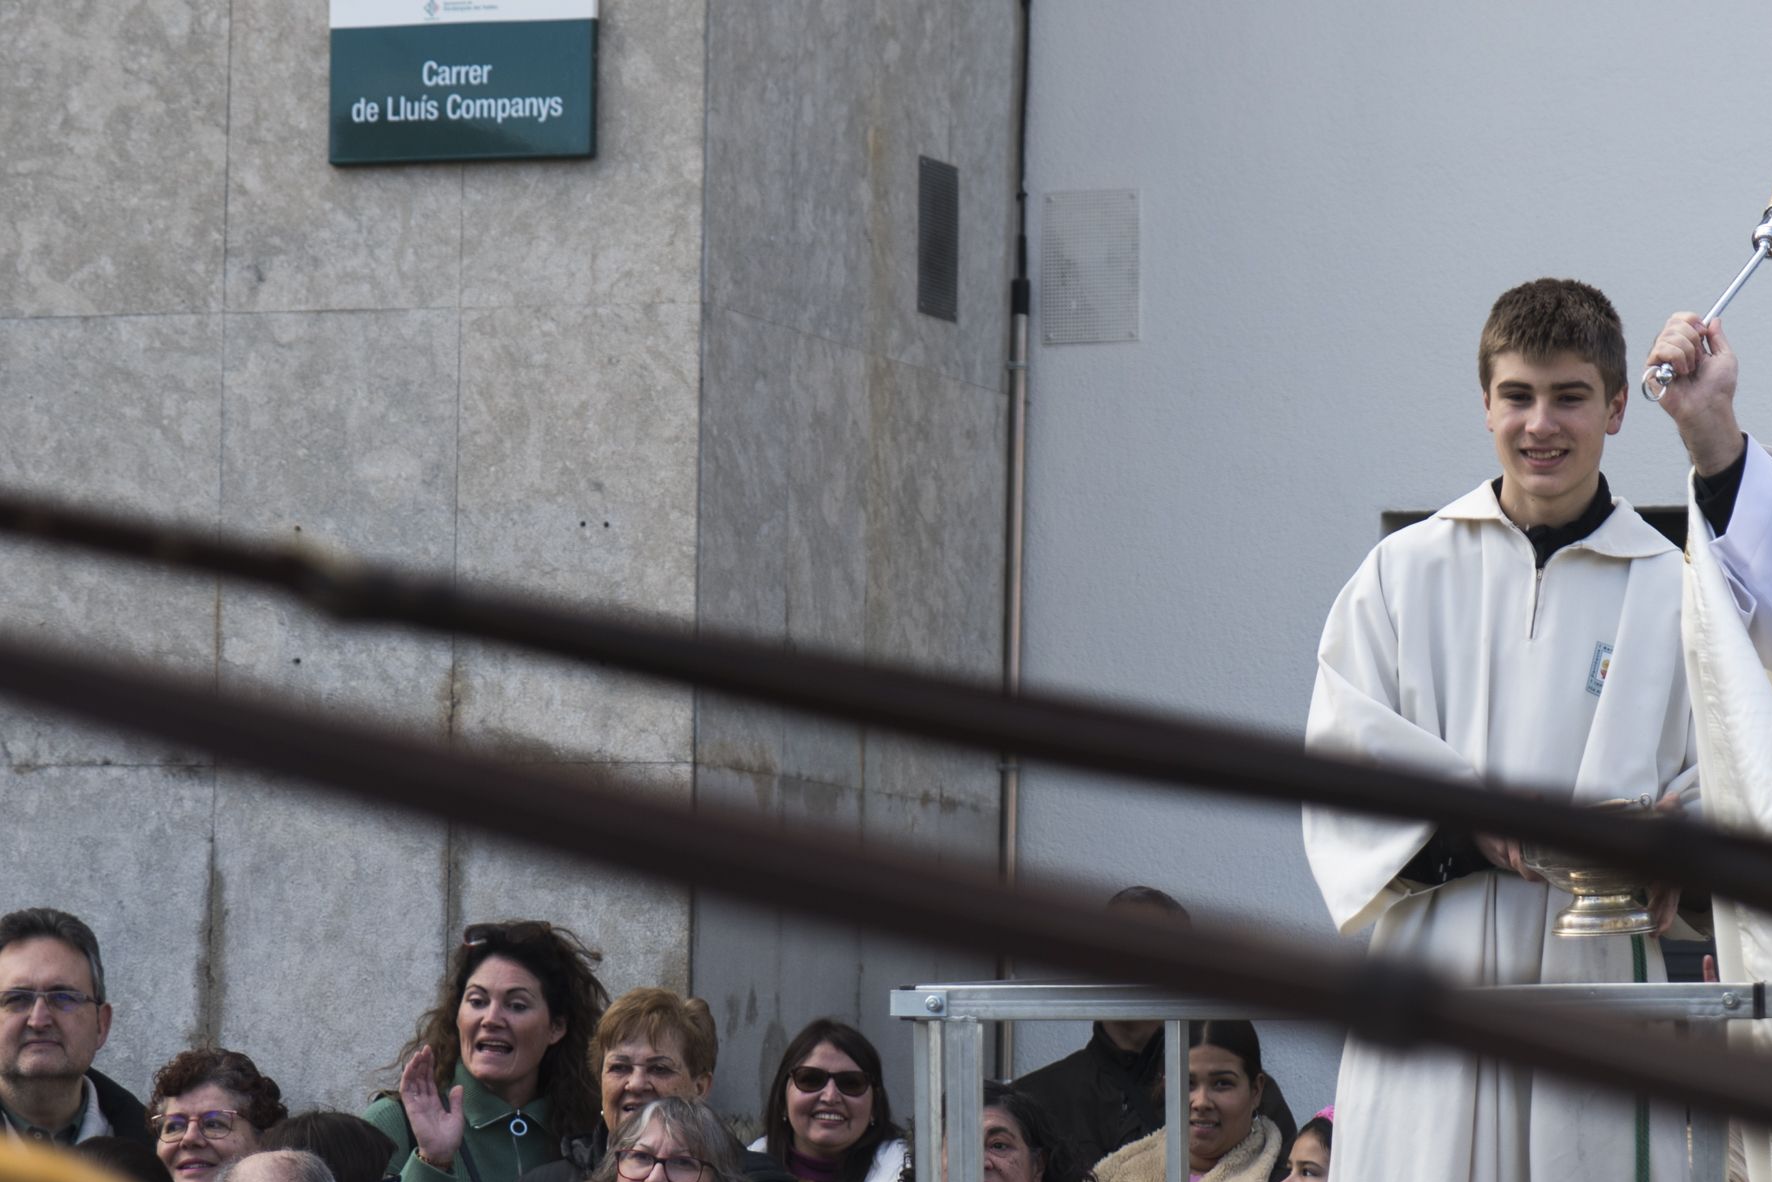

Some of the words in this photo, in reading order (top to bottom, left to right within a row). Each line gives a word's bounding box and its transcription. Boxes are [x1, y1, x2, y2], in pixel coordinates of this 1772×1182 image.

[422, 60, 493, 87] Carrer
[351, 97, 380, 122] de
[386, 94, 440, 121] Lluís
[446, 93, 563, 123] Companys
